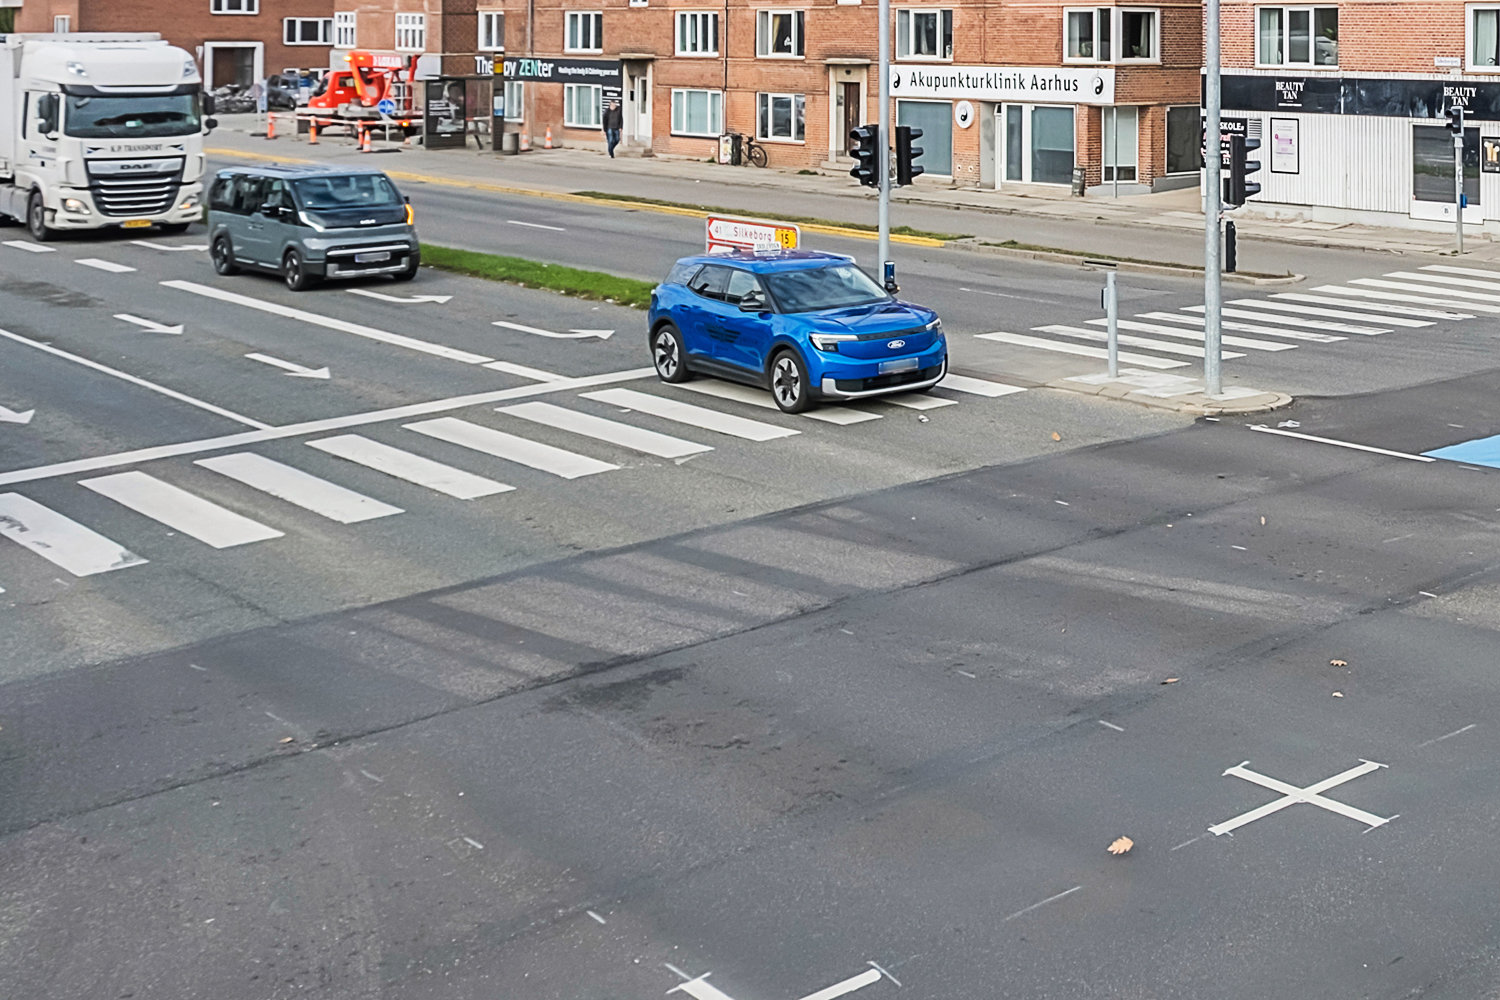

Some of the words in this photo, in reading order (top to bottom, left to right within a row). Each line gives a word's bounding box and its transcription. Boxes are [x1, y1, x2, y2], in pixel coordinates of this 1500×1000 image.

[475, 56, 516, 77] Thepy
[519, 59, 554, 78] ZENter
[910, 71, 1026, 91] Akupunkturklinik
[1030, 74, 1079, 92] Aarhus
[1275, 81, 1305, 92] BEAUTY
[1282, 90, 1298, 100] TAN
[1443, 86, 1477, 98] BEAUTY
[1451, 96, 1469, 106] TAN
[733, 226, 772, 242] Silkeborg
[781, 233, 790, 245] 15
